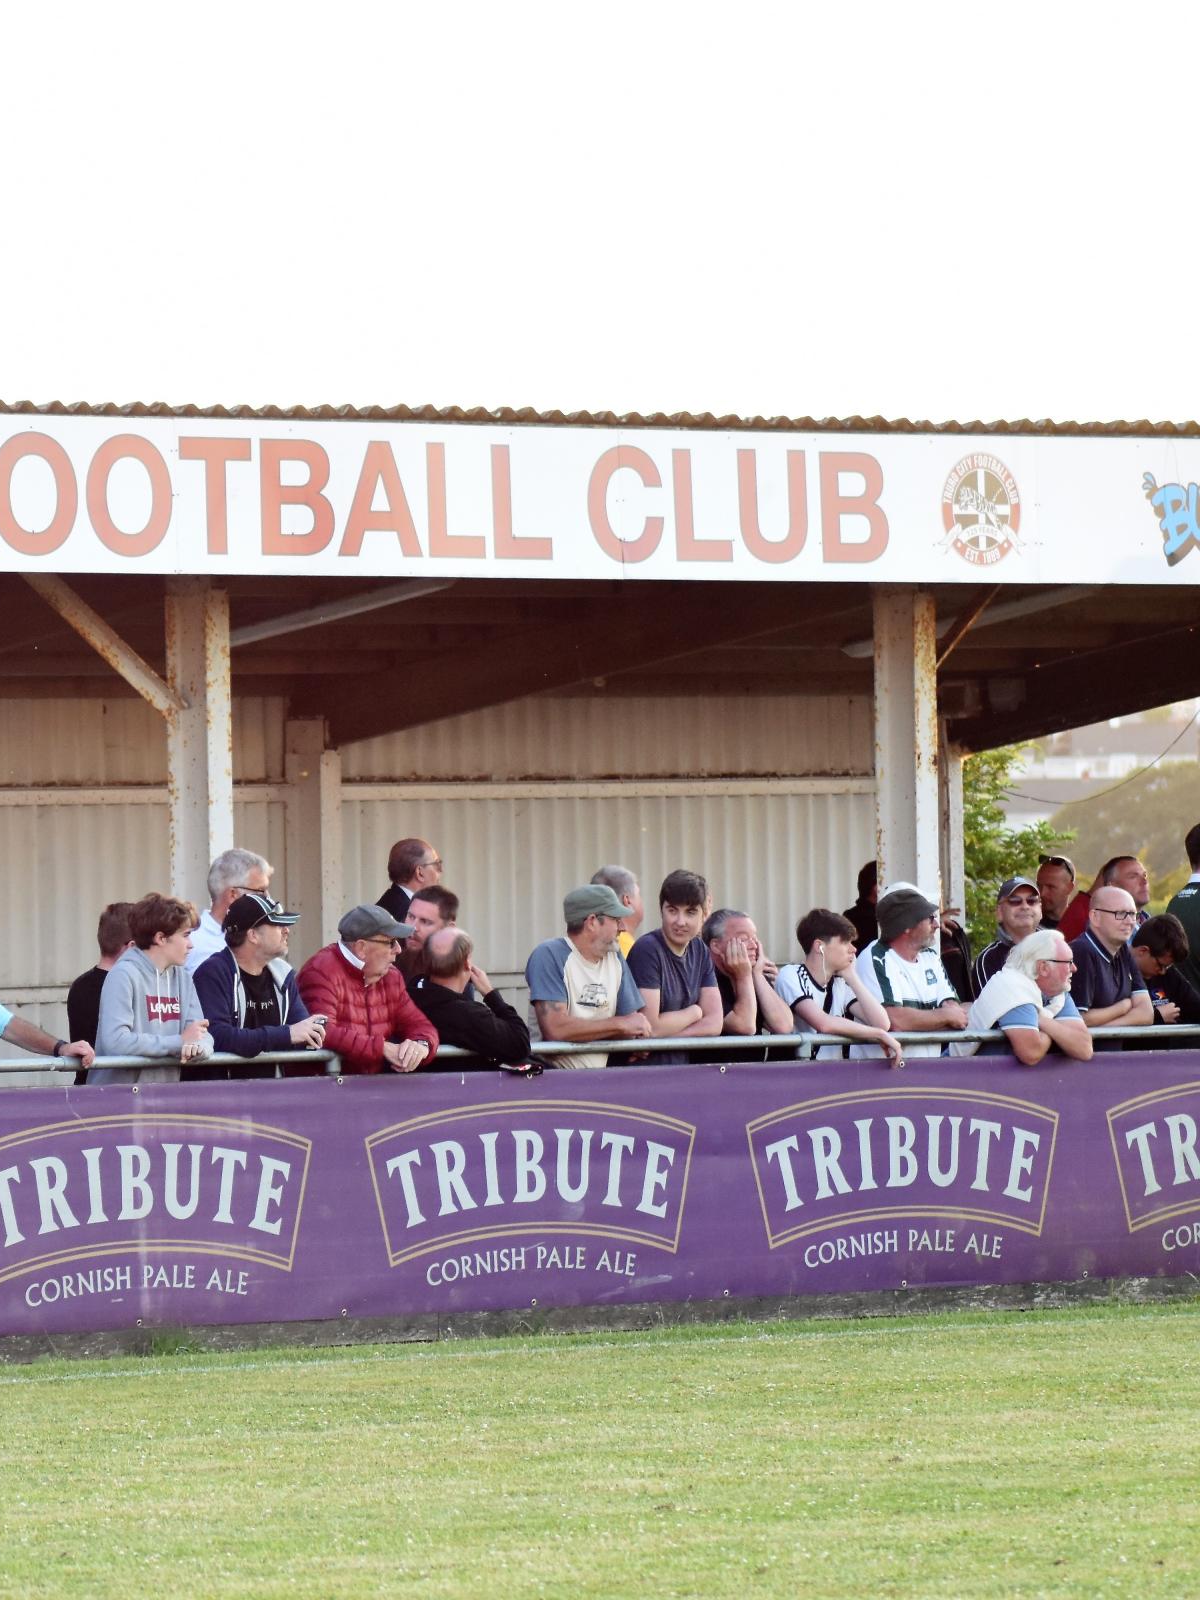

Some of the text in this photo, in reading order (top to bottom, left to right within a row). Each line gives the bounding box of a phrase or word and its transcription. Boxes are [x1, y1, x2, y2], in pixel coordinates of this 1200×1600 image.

[589, 446, 889, 562] CLUB
[385, 1128, 676, 1229] TRIBUTE
[766, 1115, 1041, 1212] TRIBUTE
[426, 1245, 637, 1286] CORNISH PALE ALE
[804, 1229, 1003, 1268] CORNISH PALE ALE
[24, 1264, 249, 1307] CORNISH PALE ALE
